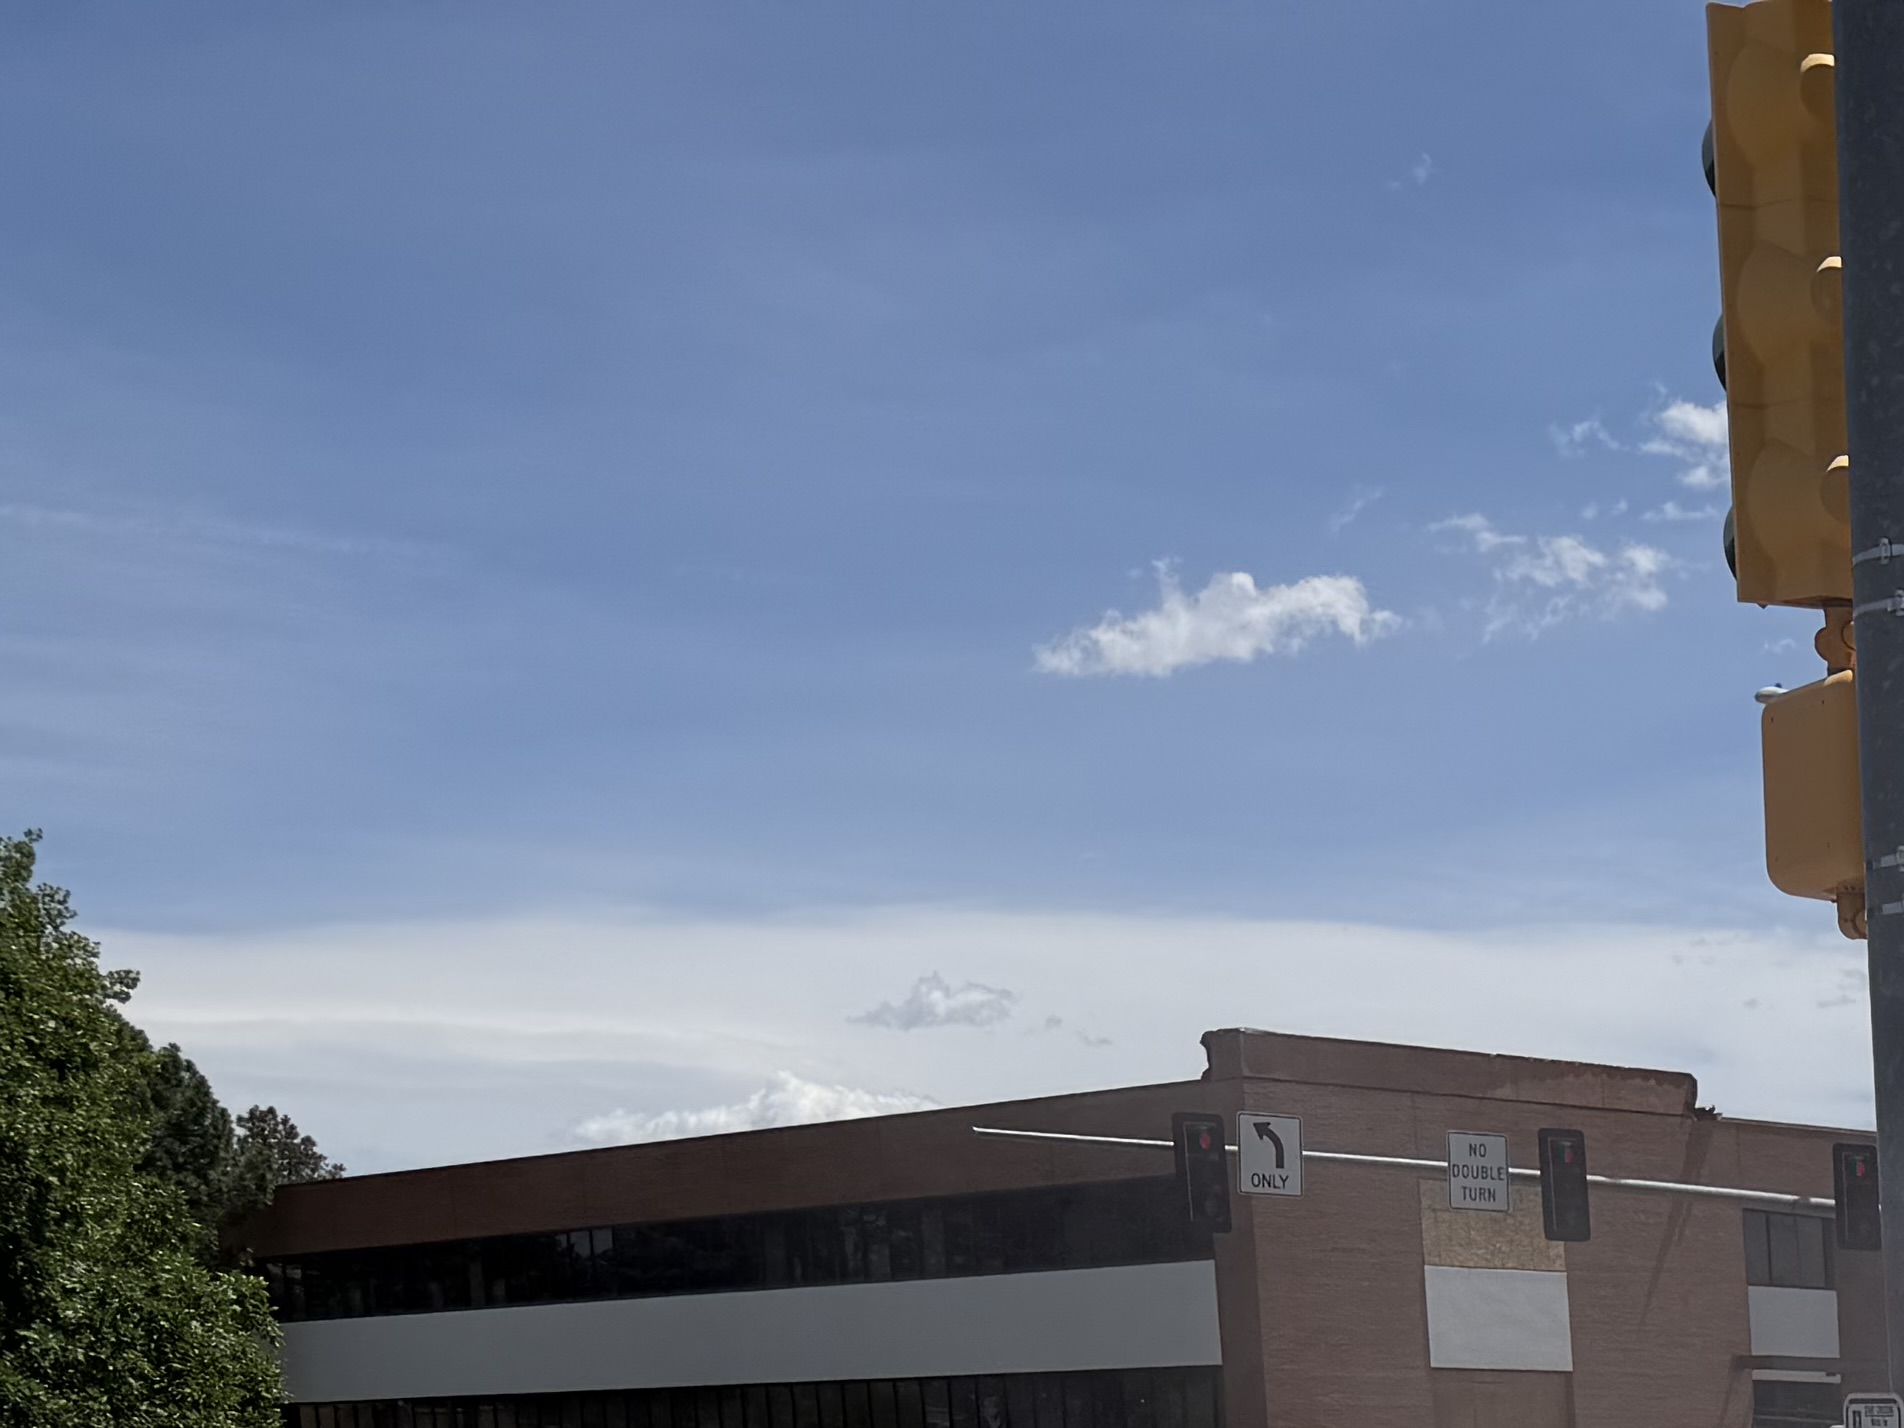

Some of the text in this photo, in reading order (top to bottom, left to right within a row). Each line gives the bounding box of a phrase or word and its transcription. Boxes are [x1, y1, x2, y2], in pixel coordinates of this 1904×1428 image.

[1468, 1143, 1487, 1158] NO
[1452, 1163, 1505, 1181] DOUBLE
[1251, 1172, 1289, 1190] ONLY
[1461, 1185, 1496, 1202] TURN
